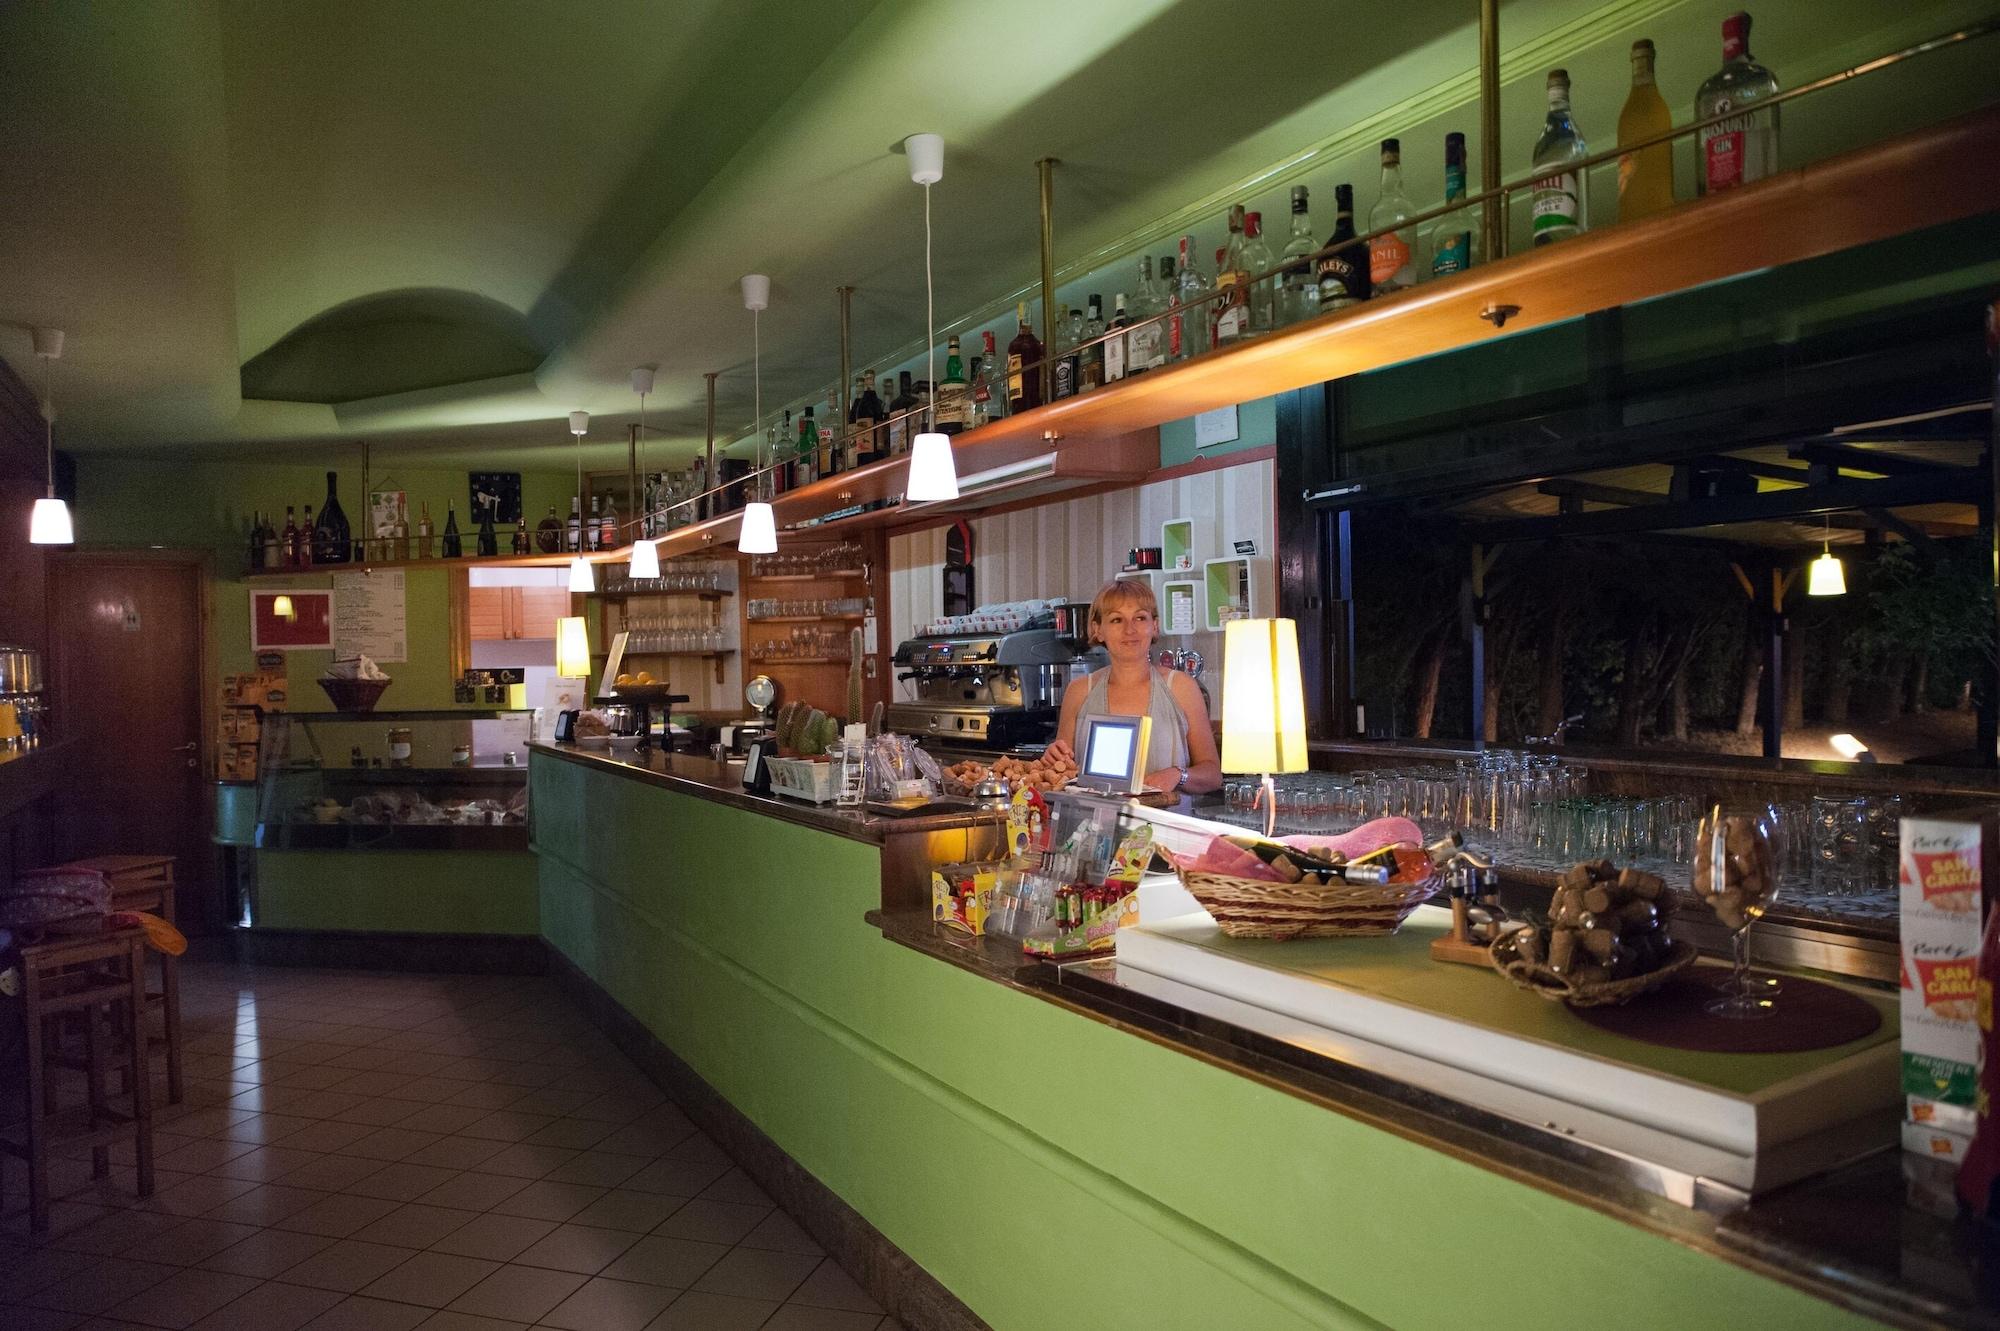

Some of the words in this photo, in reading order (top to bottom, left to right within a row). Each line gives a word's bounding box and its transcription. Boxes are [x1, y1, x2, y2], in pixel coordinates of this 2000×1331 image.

[1912, 836, 1965, 849] Party
[1931, 858, 1969, 874] SAN
[1913, 943, 1969, 957] Party
[1934, 967, 1971, 981] SAN
